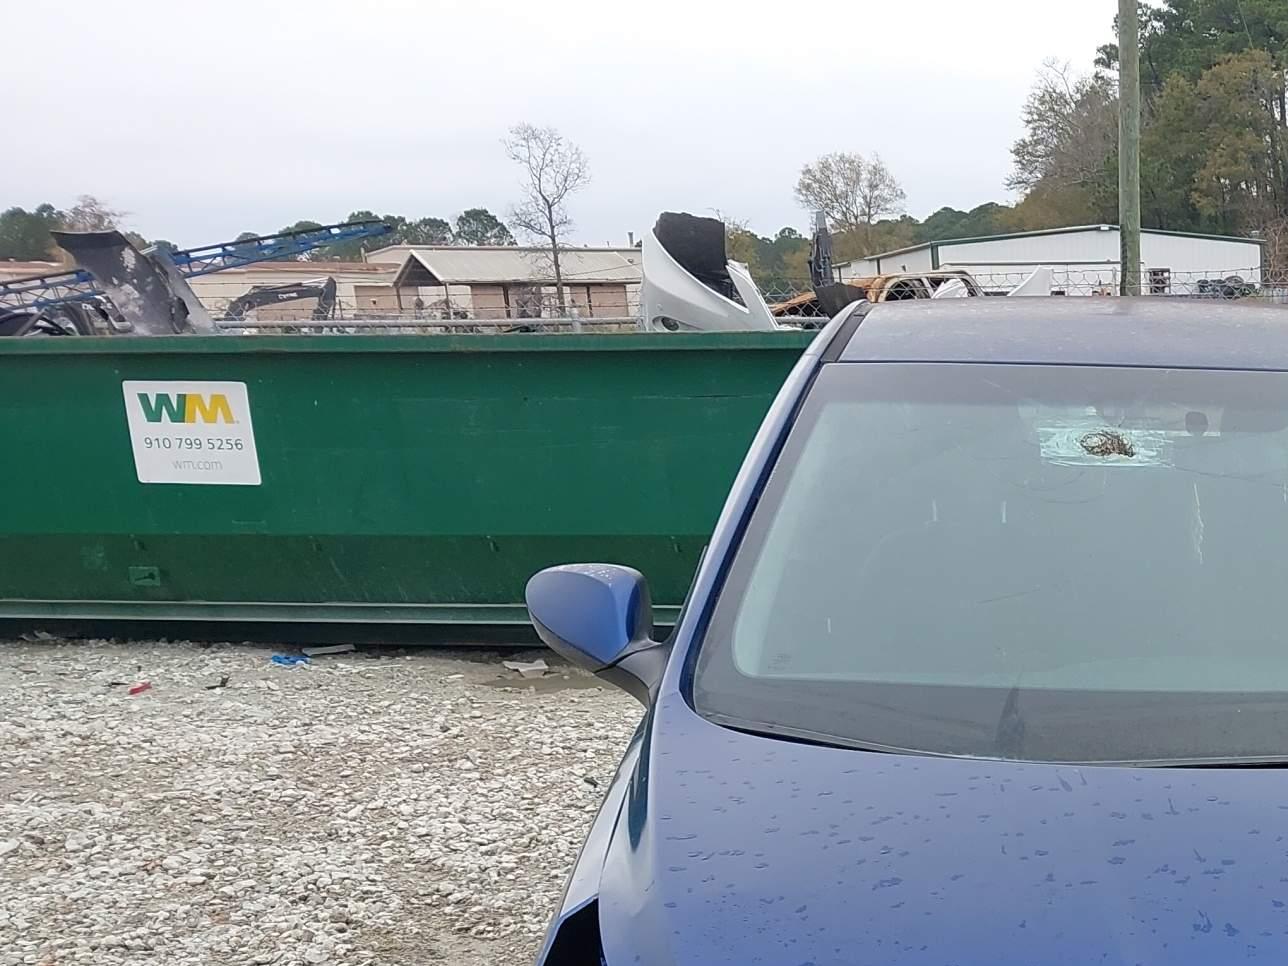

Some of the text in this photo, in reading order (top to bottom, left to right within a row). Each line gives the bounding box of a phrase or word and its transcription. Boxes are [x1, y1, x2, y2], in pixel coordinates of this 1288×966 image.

[137, 392, 236, 424] WM
[144, 437, 243, 450] 910 799 5256
[173, 460, 223, 471] wm.com
